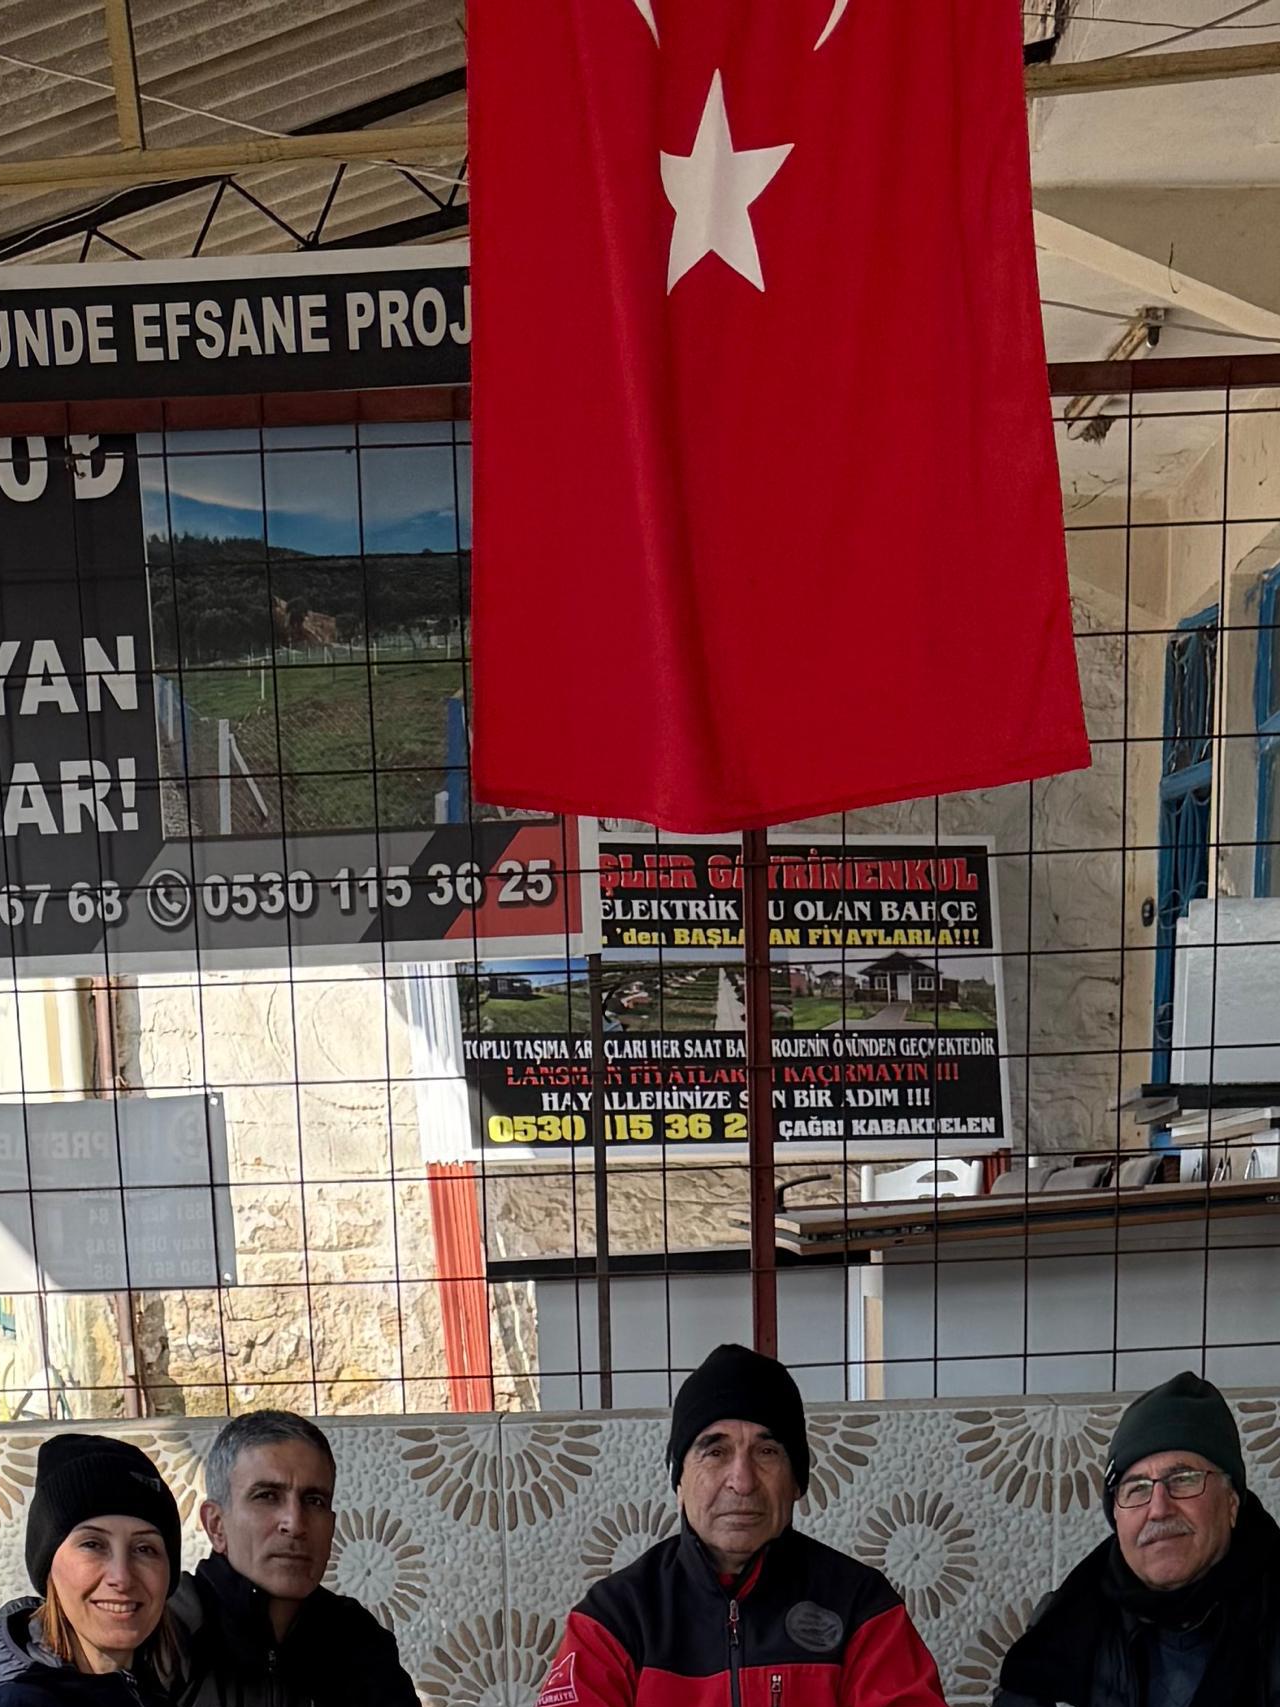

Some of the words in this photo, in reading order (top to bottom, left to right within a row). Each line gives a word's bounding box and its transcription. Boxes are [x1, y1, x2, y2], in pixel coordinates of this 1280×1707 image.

[132, 294, 330, 362] EFSANE
[203, 870, 313, 917] 0530
[330, 866, 412, 911] 115
[427, 861, 482, 906] 36
[498, 859, 553, 903] 25
[67, 881, 123, 926] 68
[601, 893, 740, 921] ELEKTRİK
[793, 900, 872, 922] OLAN
[880, 900, 978, 928] BAHÇE
[673, 927, 801, 950] BAŞLAN
[464, 1039, 511, 1060] TOPLU
[515, 1039, 569, 1065] TAŞIMA
[572, 1039, 649, 1064] ARÇLARI
[651, 1038, 681, 1058] HER
[683, 1038, 722, 1059] SAAT
[771, 1033, 830, 1058] ROJENİN
[507, 1065, 622, 1086] LANSMN
[740, 1088, 786, 1110] SN
[794, 1084, 834, 1108] BİR
[842, 1087, 900, 1108] ADIM
[488, 1115, 586, 1142] 0530
[665, 1113, 712, 1139] 36
[724, 1113, 748, 1139] 2
[779, 1115, 844, 1142] ÇAĞRI
